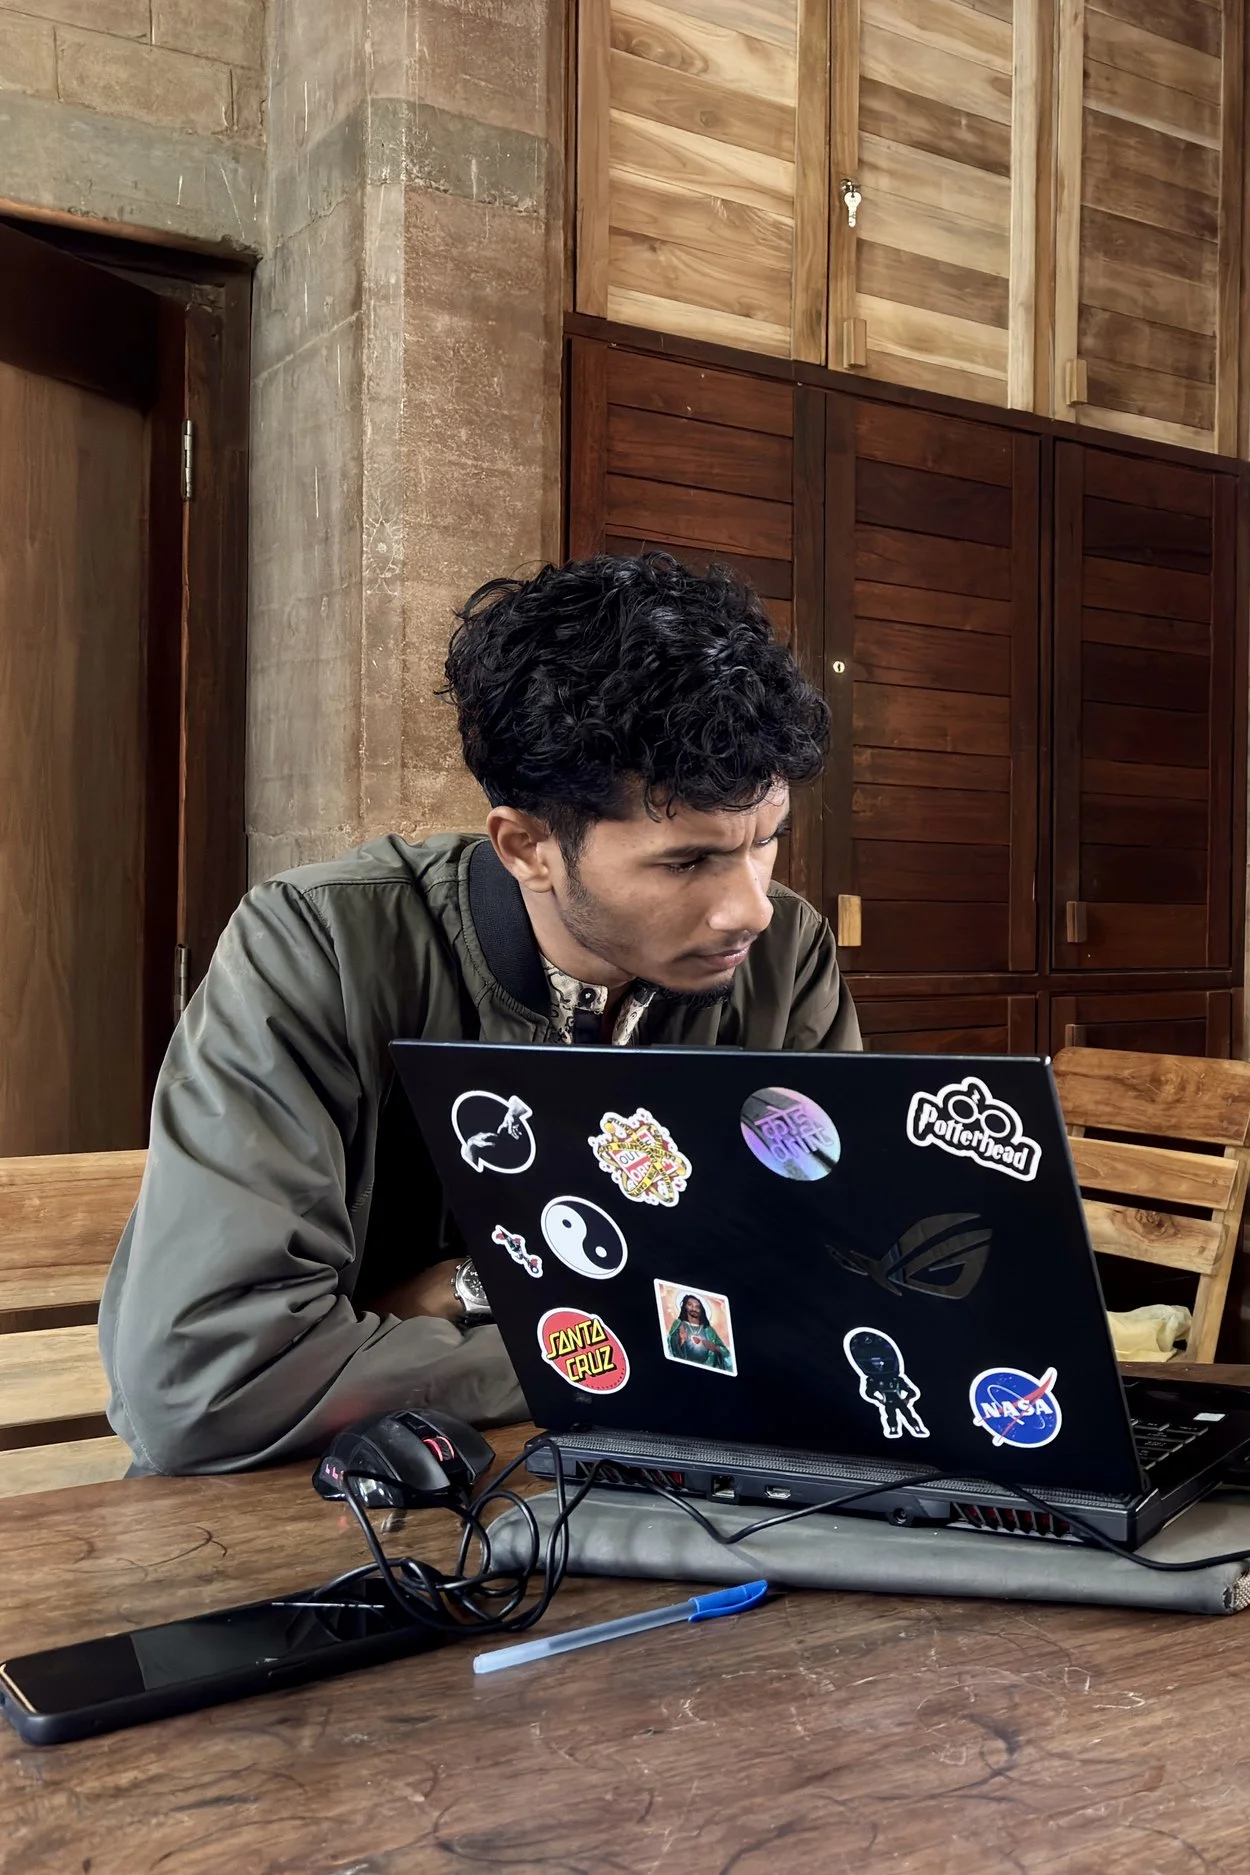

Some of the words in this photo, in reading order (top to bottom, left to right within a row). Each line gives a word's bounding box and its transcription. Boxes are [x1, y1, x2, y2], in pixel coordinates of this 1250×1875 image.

[919, 1102, 1029, 1170] Potterhead
[547, 1318, 607, 1359] SANTA
[565, 1345, 615, 1382] CRUZ
[980, 1398, 1053, 1418] NASA
